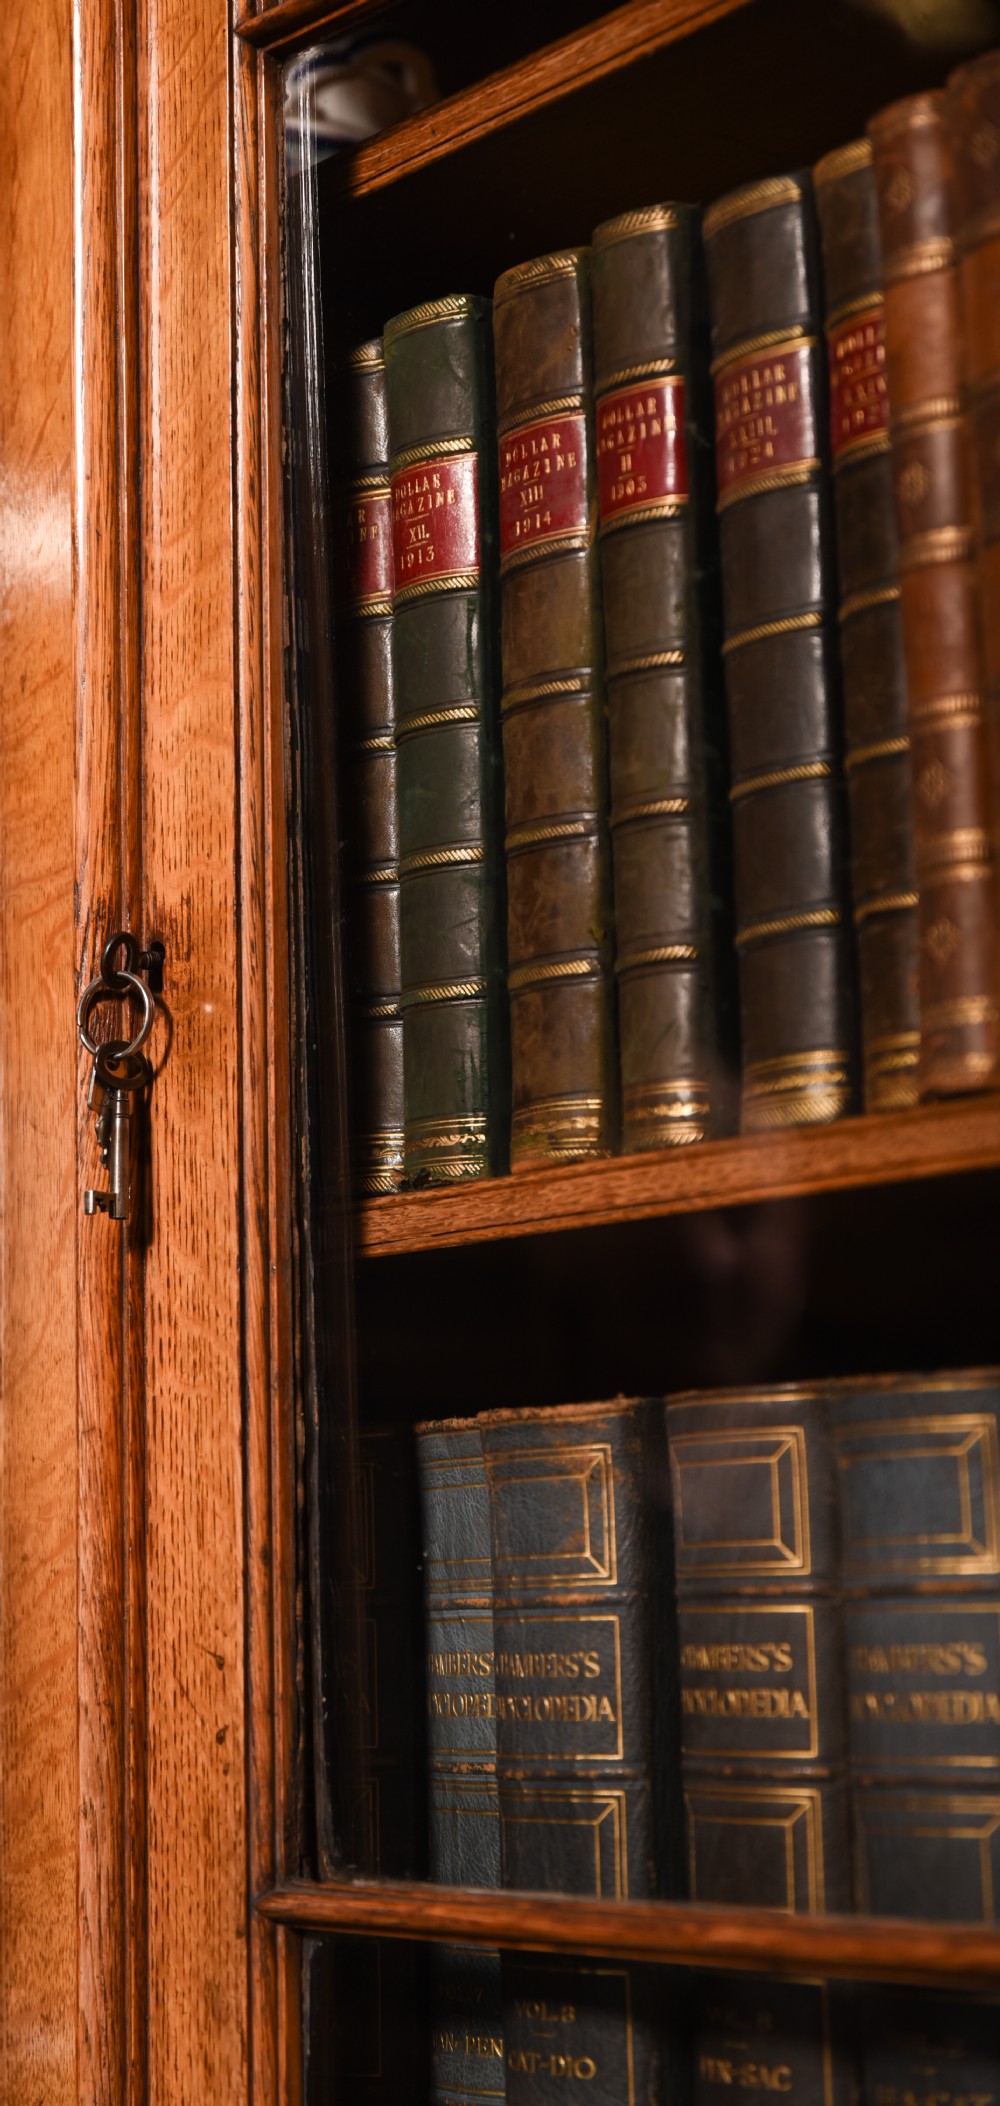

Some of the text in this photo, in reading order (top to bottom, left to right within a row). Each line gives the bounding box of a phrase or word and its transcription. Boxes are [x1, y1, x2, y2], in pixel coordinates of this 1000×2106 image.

[505, 433, 561, 468] DOLLAR
[515, 510, 552, 536] 1914
[401, 545, 435, 570] 1913
